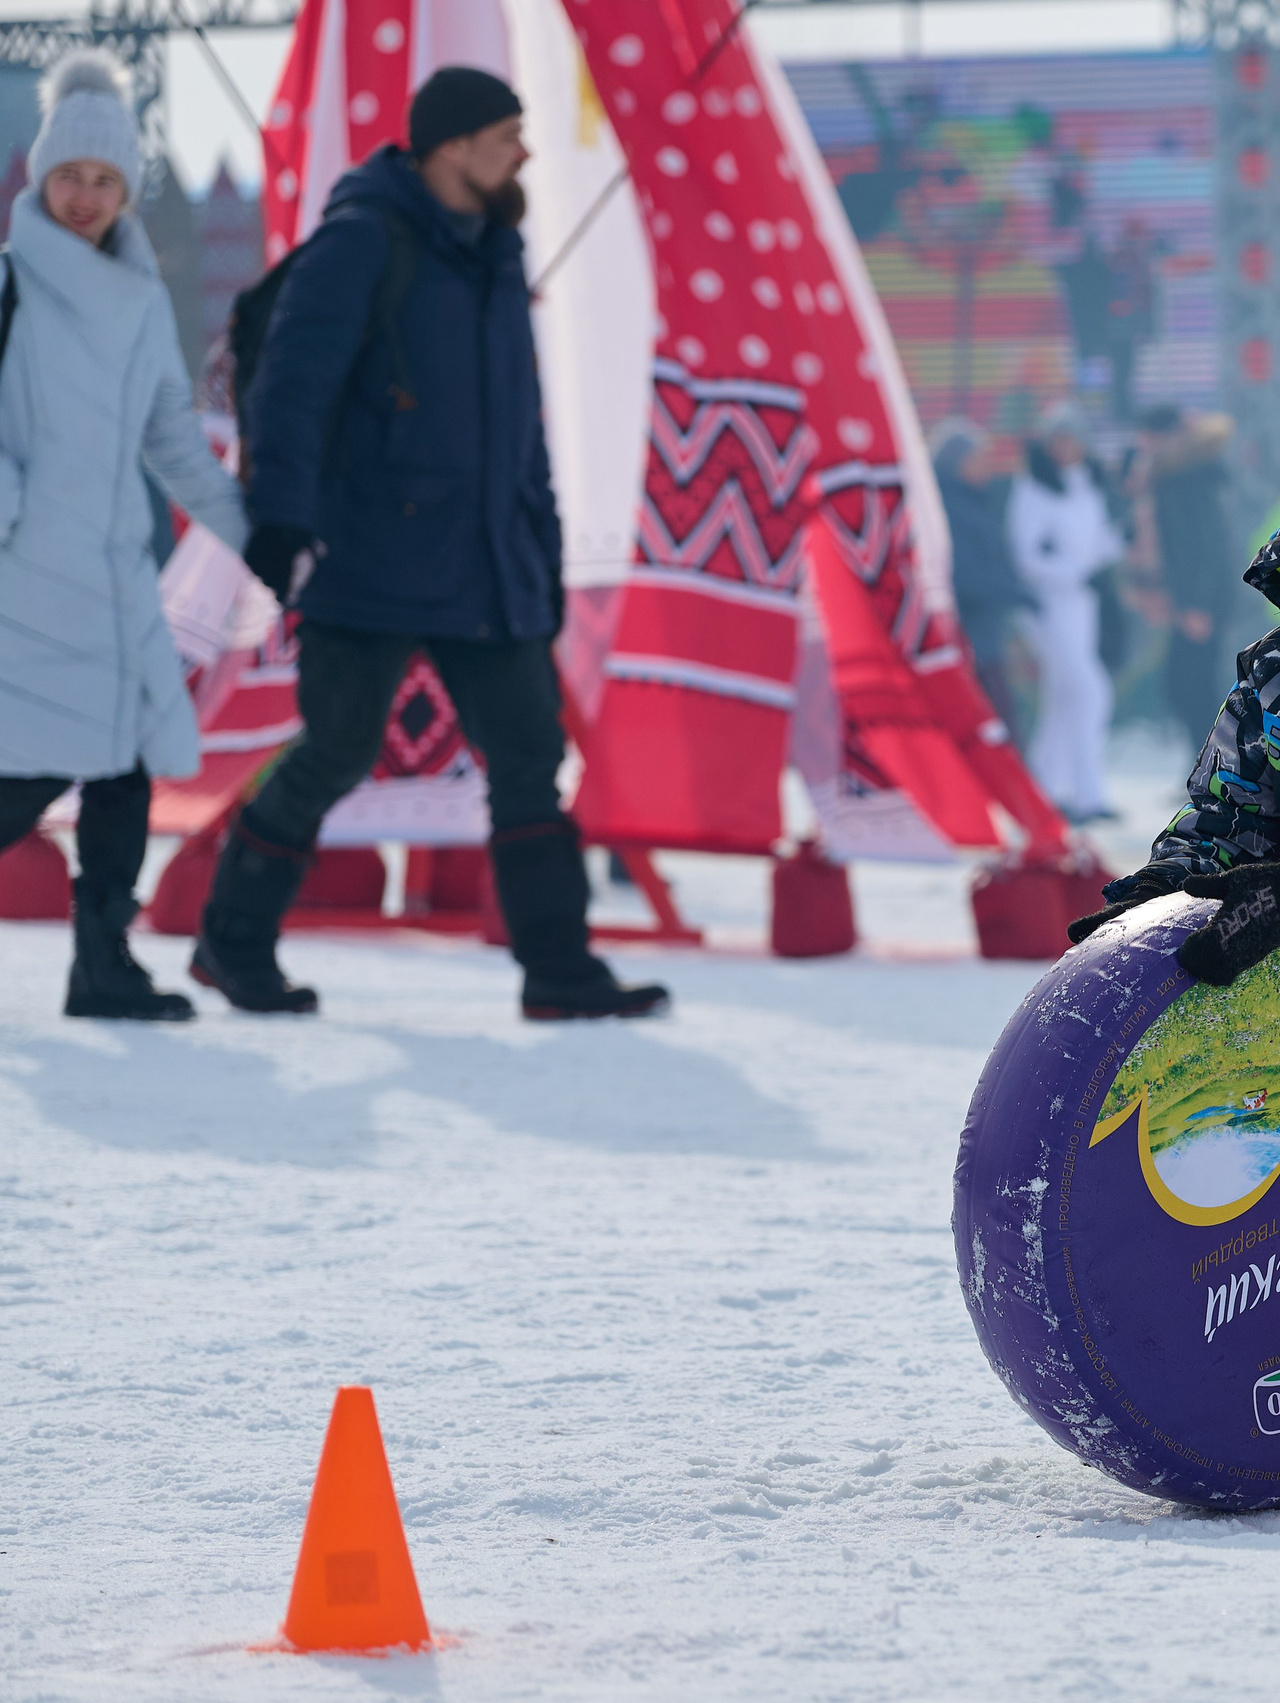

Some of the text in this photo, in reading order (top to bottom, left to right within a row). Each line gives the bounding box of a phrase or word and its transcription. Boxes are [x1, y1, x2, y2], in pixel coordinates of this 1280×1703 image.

[1156, 977, 1176, 997] 120
[1119, 1004, 1149, 1040] АЛТАЯ
[1078, 1040, 1121, 1116] ПРЕДГОРЬЯХ
[1073, 1120, 1084, 1129] В
[1059, 1134, 1080, 1231] ПРОИЗВЕДЕНО
[1191, 1218, 1280, 1286] твердый
[1063, 1247, 1080, 1306] СОЗРЕВАНИЯ
[1074, 1306, 1087, 1331] СРОК
[1080, 1332, 1105, 1371] СУТОК
[1101, 1371, 1119, 1391] 120
[1120, 1398, 1150, 1429] АЛТАЯ
[1150, 1426, 1213, 1469] ПРЕДГОРЬЯХ
[1216, 1462, 1225, 1473] В
